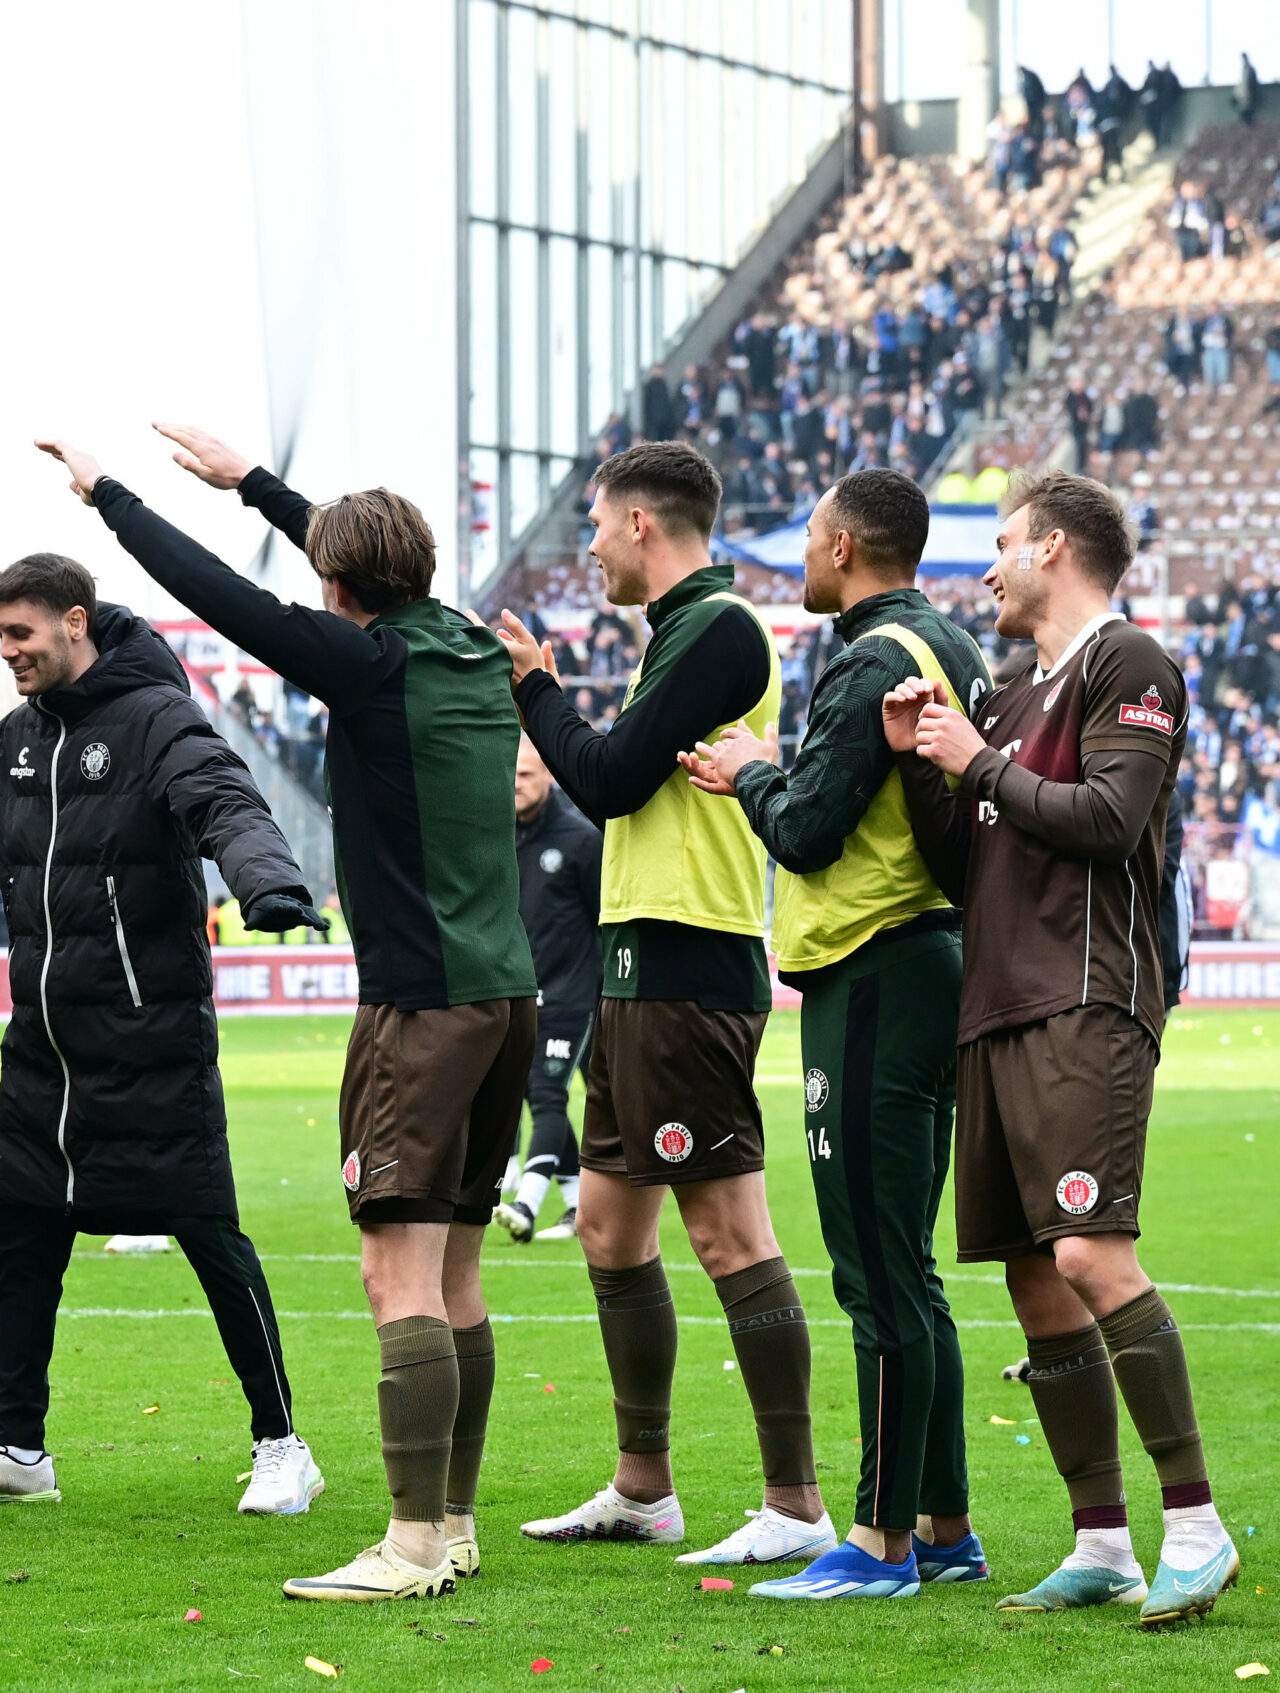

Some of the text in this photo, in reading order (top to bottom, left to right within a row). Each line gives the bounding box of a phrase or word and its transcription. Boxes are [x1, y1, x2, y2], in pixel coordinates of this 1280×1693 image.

[1124, 708, 1170, 729] ASTRA
[617, 948, 632, 979] 19
[546, 1038, 572, 1059] MK
[807, 1127, 832, 1161] 14
[734, 1309, 795, 1331] PAULI
